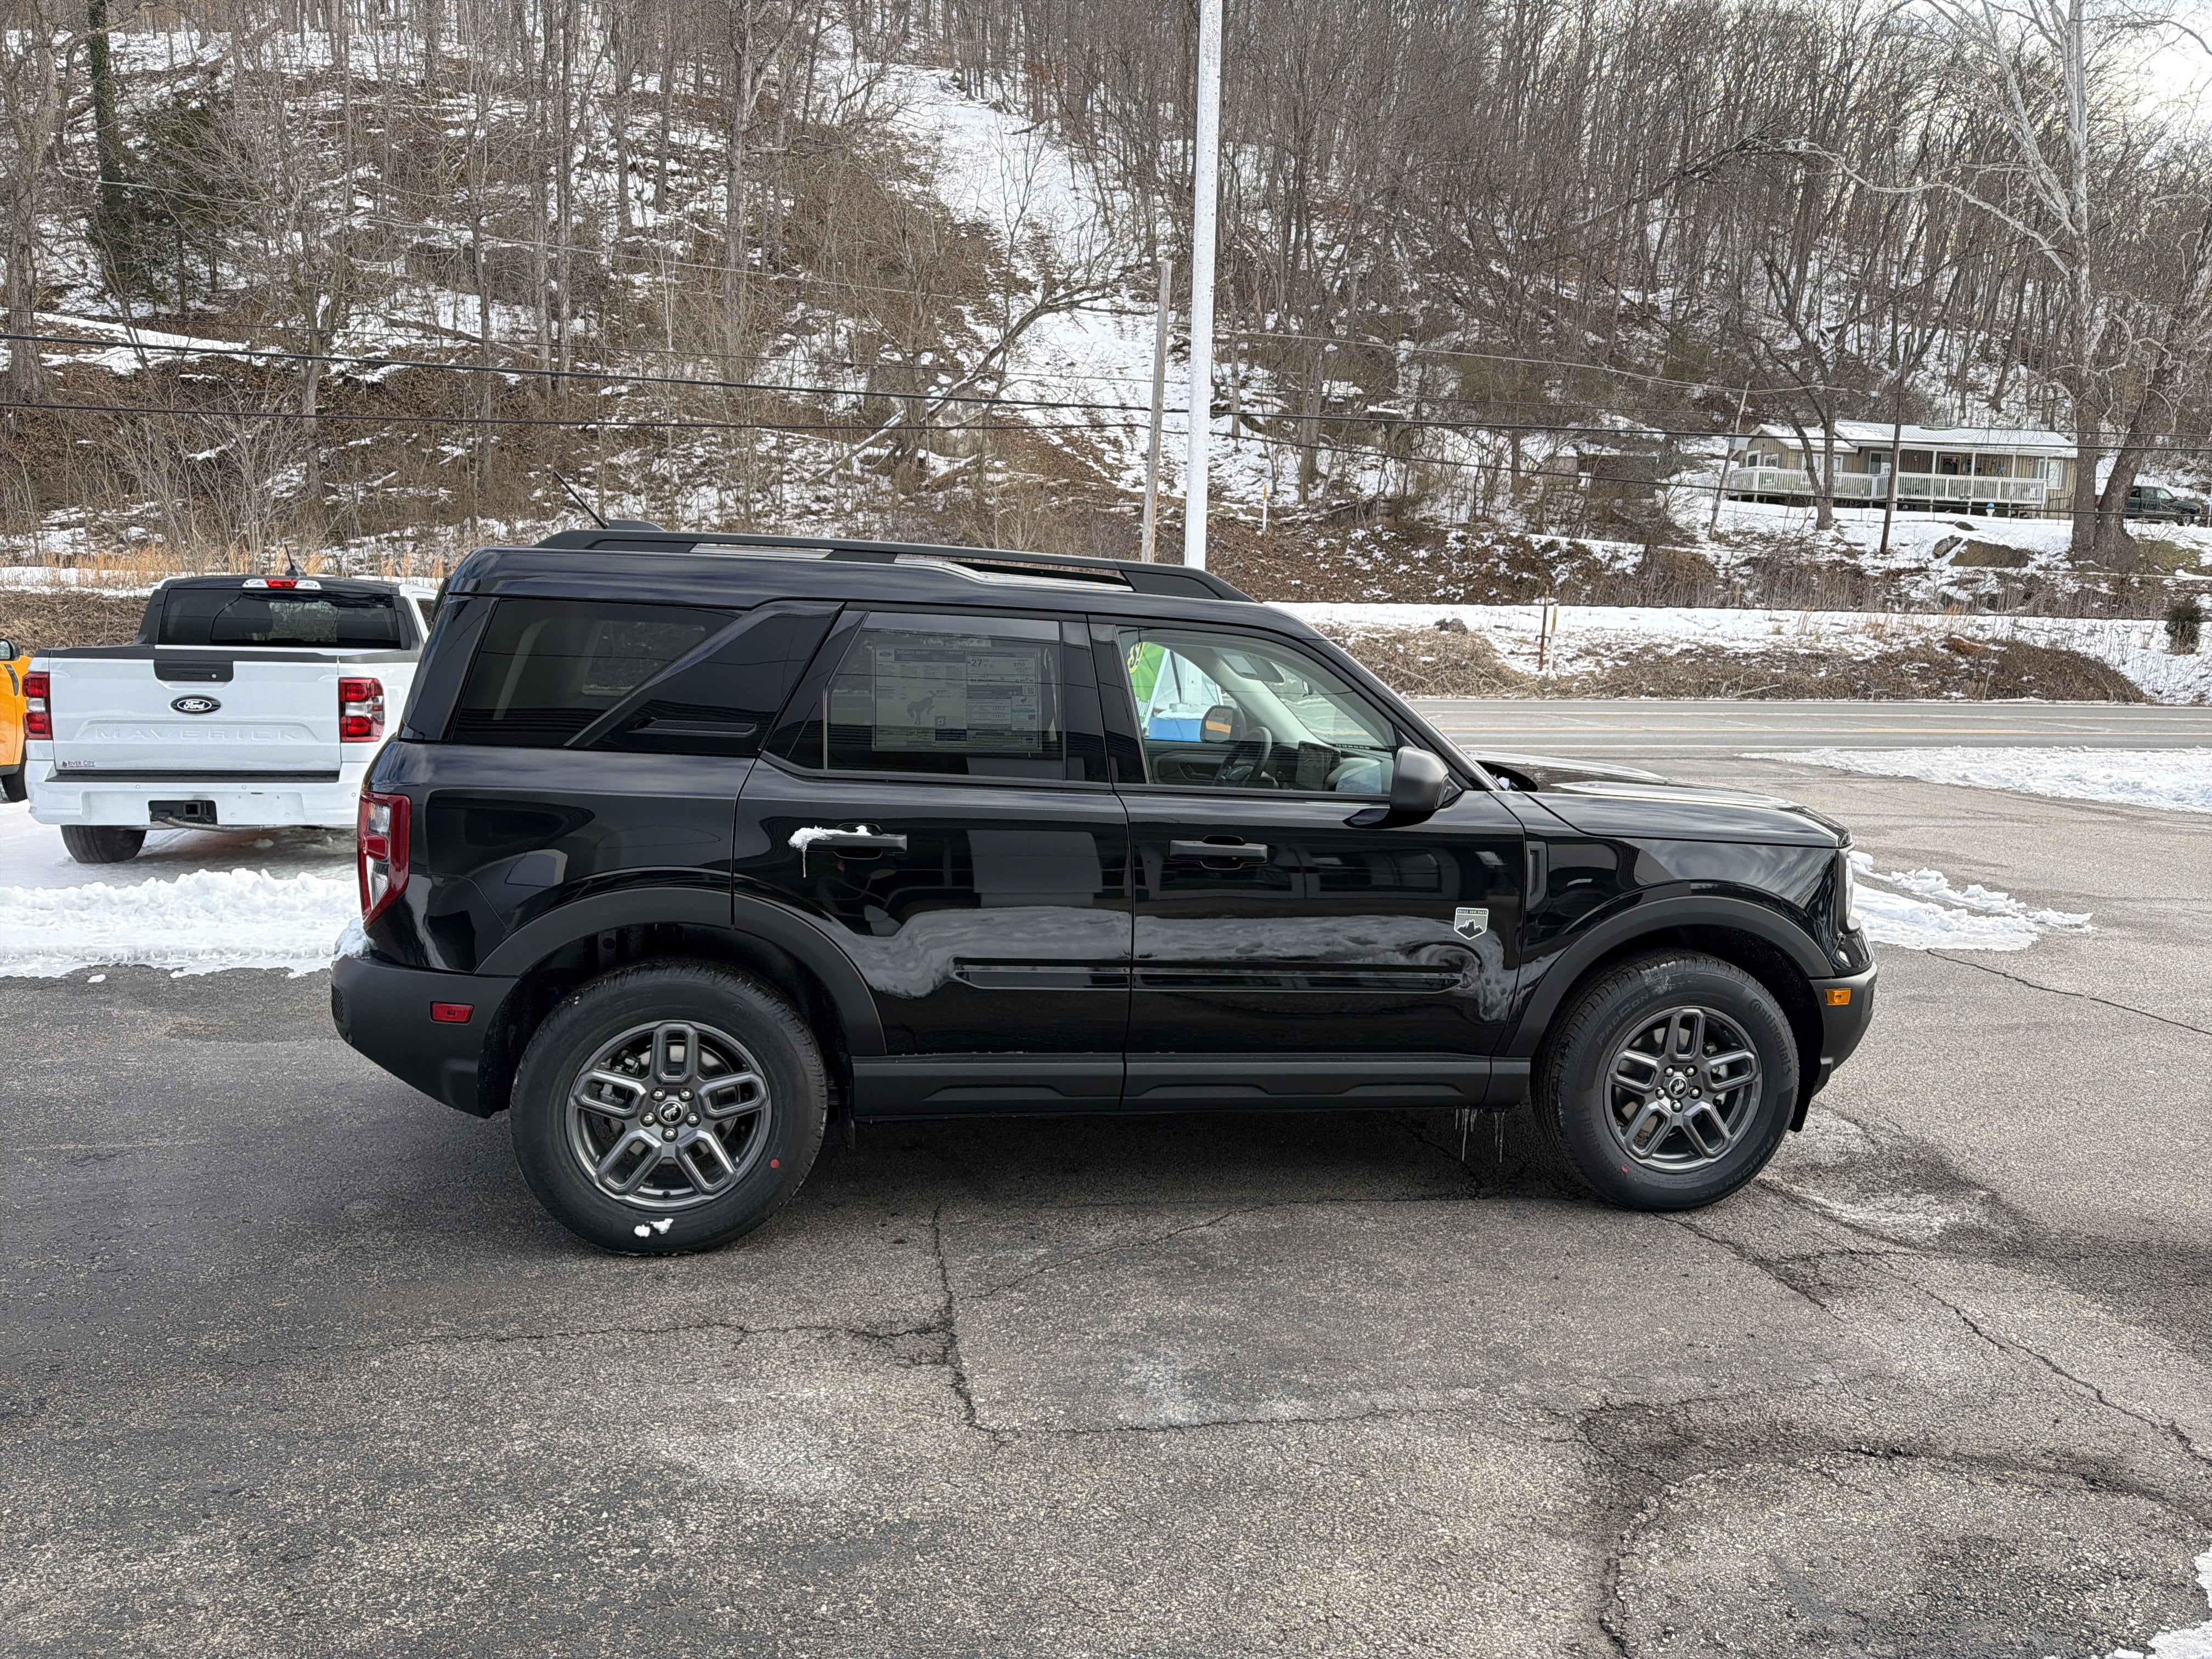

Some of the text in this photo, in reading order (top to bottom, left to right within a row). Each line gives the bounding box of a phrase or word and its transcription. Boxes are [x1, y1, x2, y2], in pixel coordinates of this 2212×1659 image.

[183, 700, 205, 709] Ford
[95, 729, 299, 741] MAVERICK
[1749, 998, 1791, 1066] Continental
